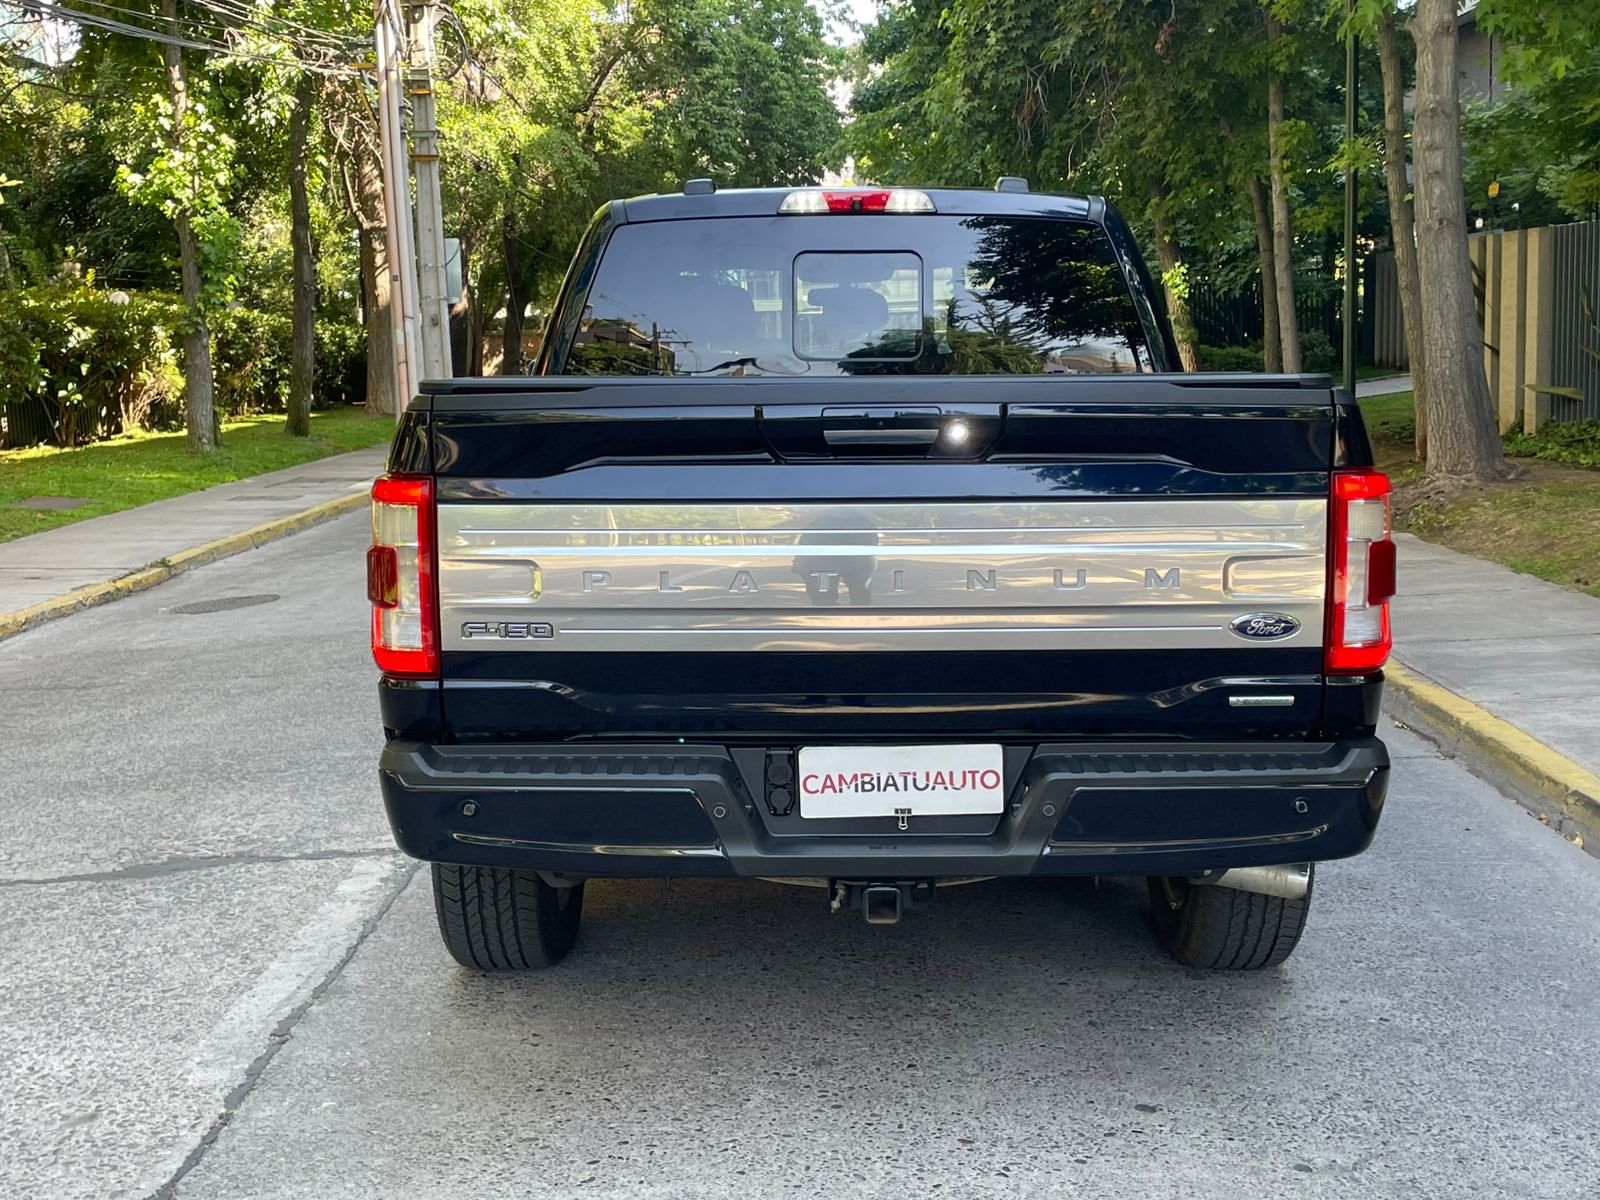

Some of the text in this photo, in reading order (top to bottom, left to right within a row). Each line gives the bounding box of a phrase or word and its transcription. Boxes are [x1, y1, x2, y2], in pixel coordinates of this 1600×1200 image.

[582, 566, 1180, 593] PLATINUM
[461, 621, 554, 639] F-150
[1246, 617, 1285, 635] Ford
[802, 769, 1001, 795] CAMBIATUAUTO
